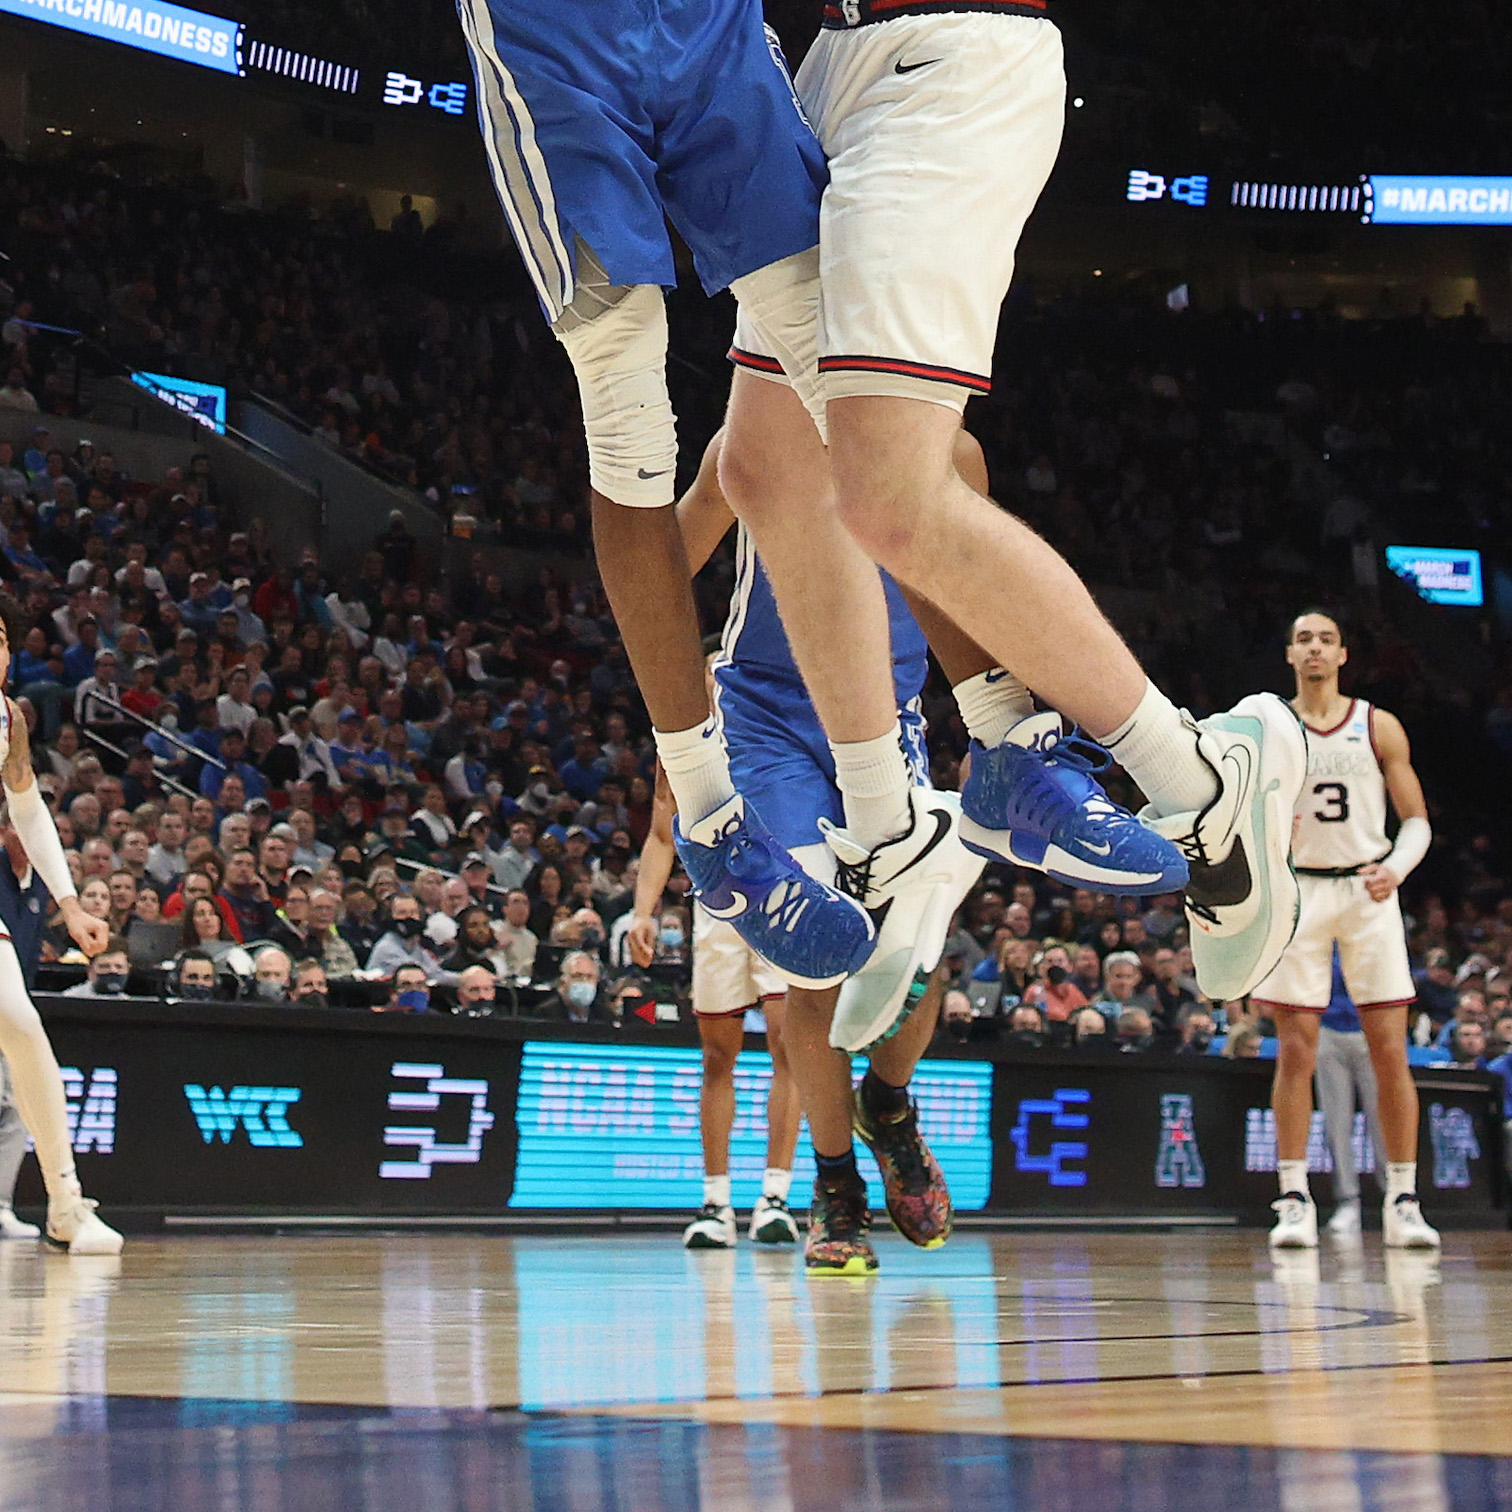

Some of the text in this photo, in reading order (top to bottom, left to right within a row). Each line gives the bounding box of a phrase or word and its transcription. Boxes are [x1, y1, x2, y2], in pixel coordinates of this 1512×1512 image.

[1308, 750, 1370, 777] AGS
[1312, 782, 1349, 822] 3
[182, 1083, 304, 1149] WCC
[536, 1062, 656, 1135] NCAA
